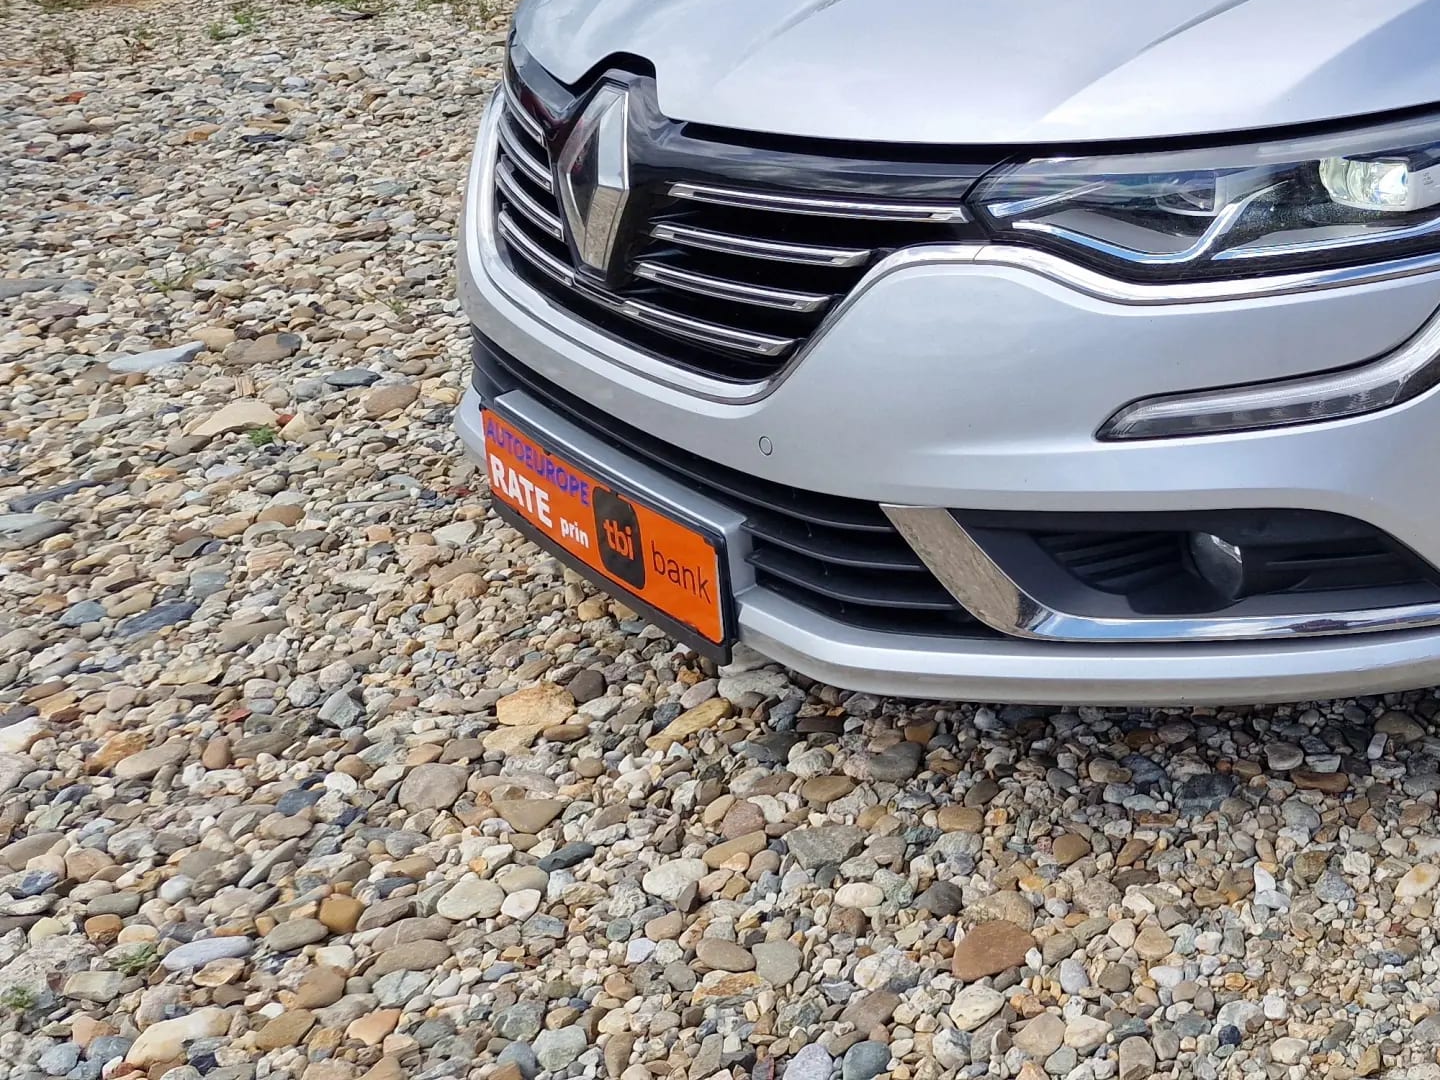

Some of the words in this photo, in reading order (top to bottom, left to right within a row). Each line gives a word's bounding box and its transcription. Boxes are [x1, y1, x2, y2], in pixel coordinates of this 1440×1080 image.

[487, 418, 590, 507] AUTOEUROPE
[490, 453, 553, 528] RATE
[560, 517, 590, 549] prin
[602, 519, 635, 561] tbi
[651, 540, 712, 604] bank
